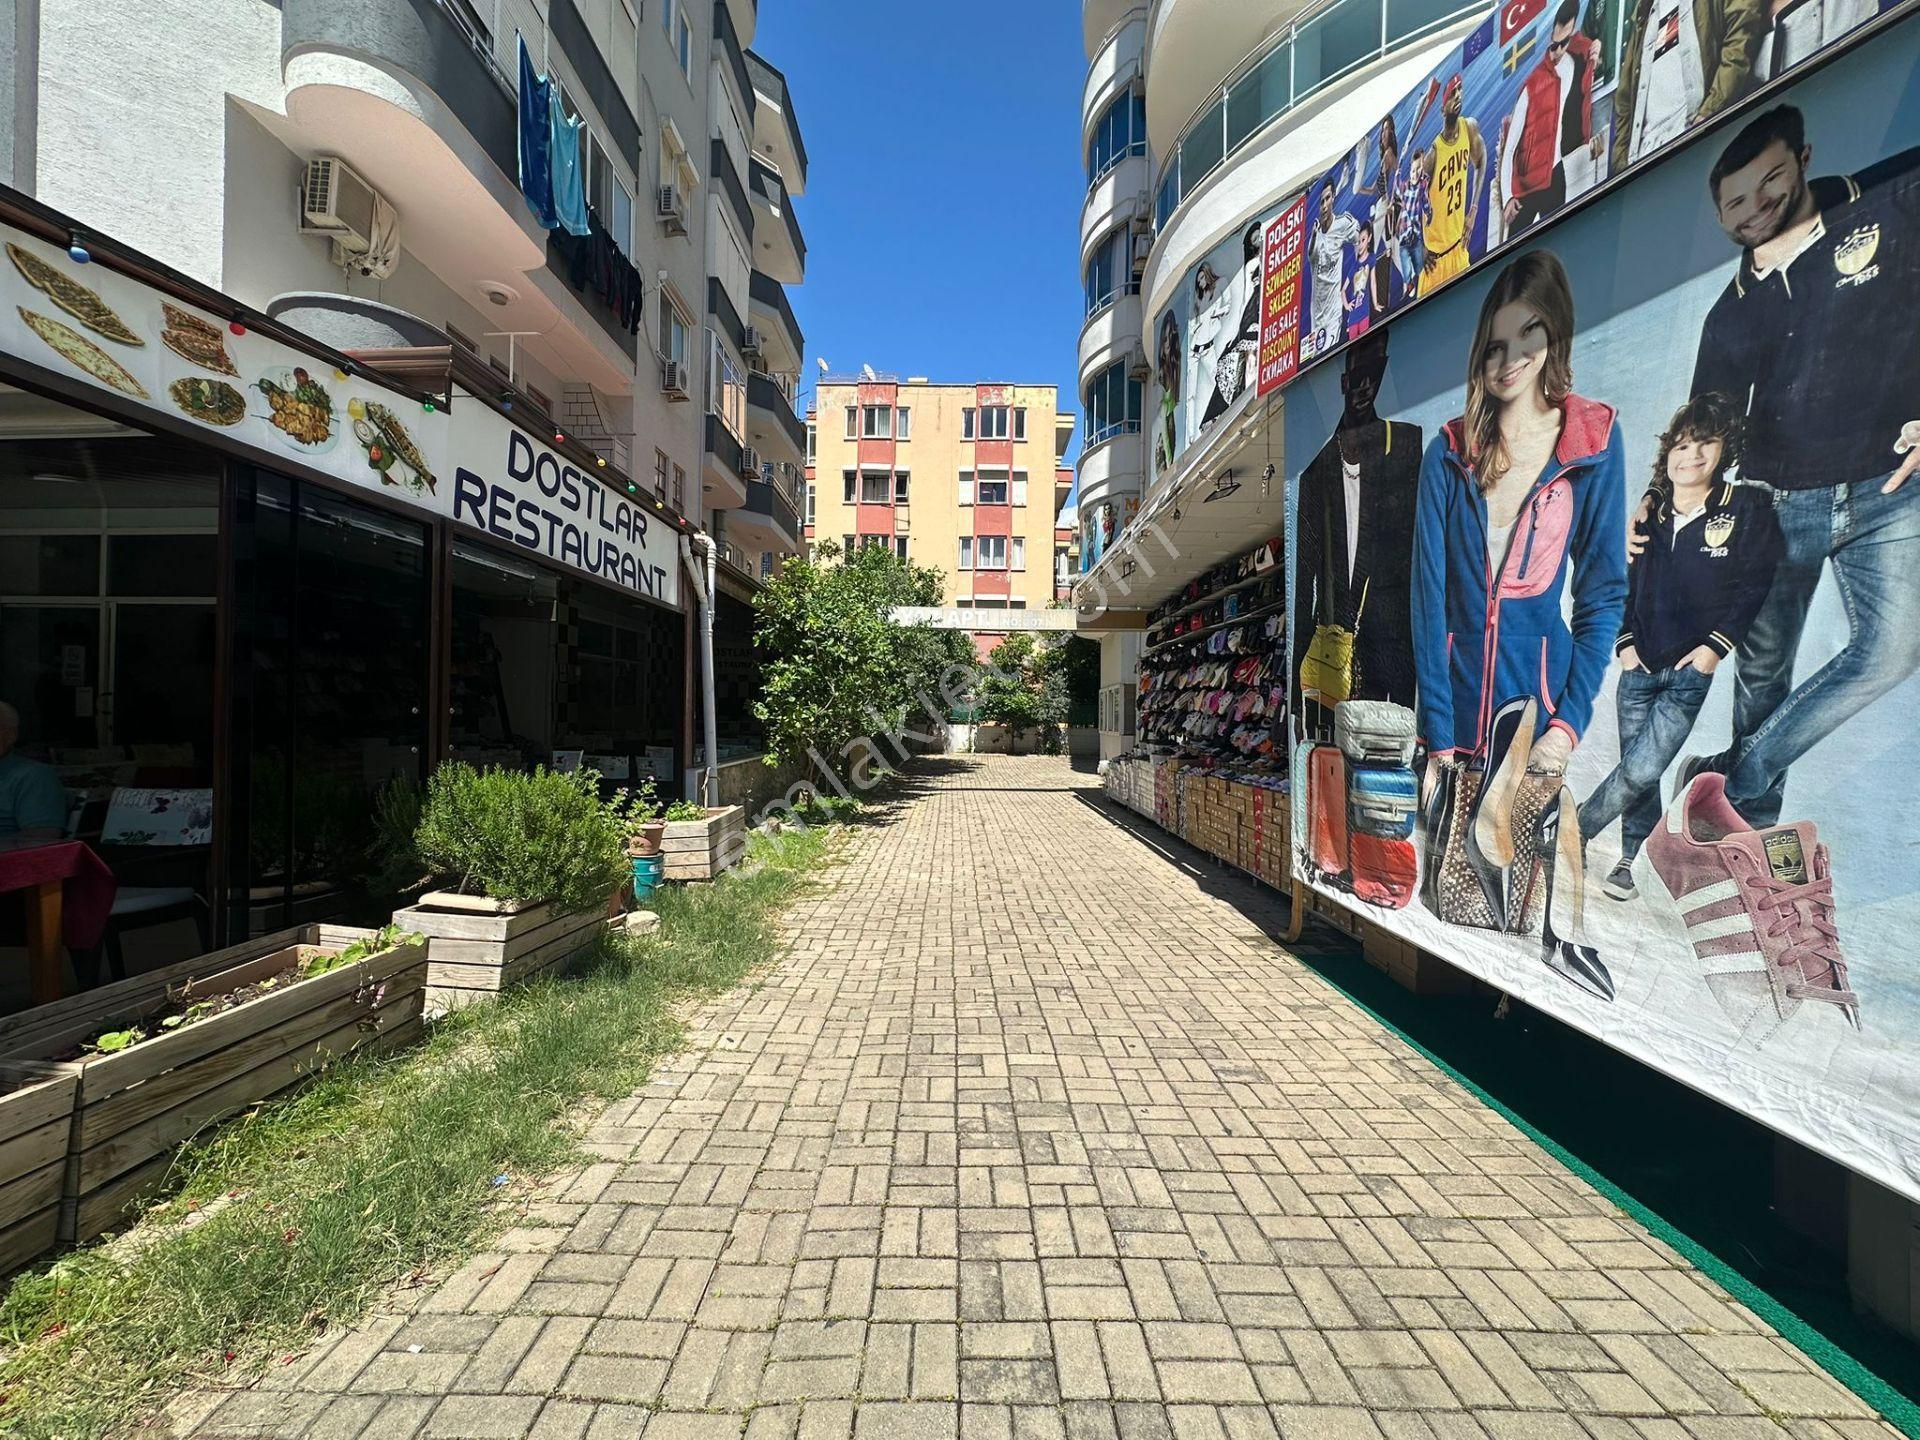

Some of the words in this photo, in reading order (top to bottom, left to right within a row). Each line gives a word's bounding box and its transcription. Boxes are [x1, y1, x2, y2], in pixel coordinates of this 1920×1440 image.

[1439, 149, 1468, 192] CAVS
[1447, 179, 1462, 216] 23
[1268, 230, 1300, 273] SKLEP
[1268, 282, 1295, 317] SKLEEP
[1264, 321, 1278, 345] BIG
[1278, 305, 1298, 335] SALE
[1261, 326, 1297, 366] DISCOUNT
[1261, 350, 1294, 385] СКИДКА
[507, 429, 648, 549] DOSTLAR
[453, 466, 667, 600] RESTAURANT
